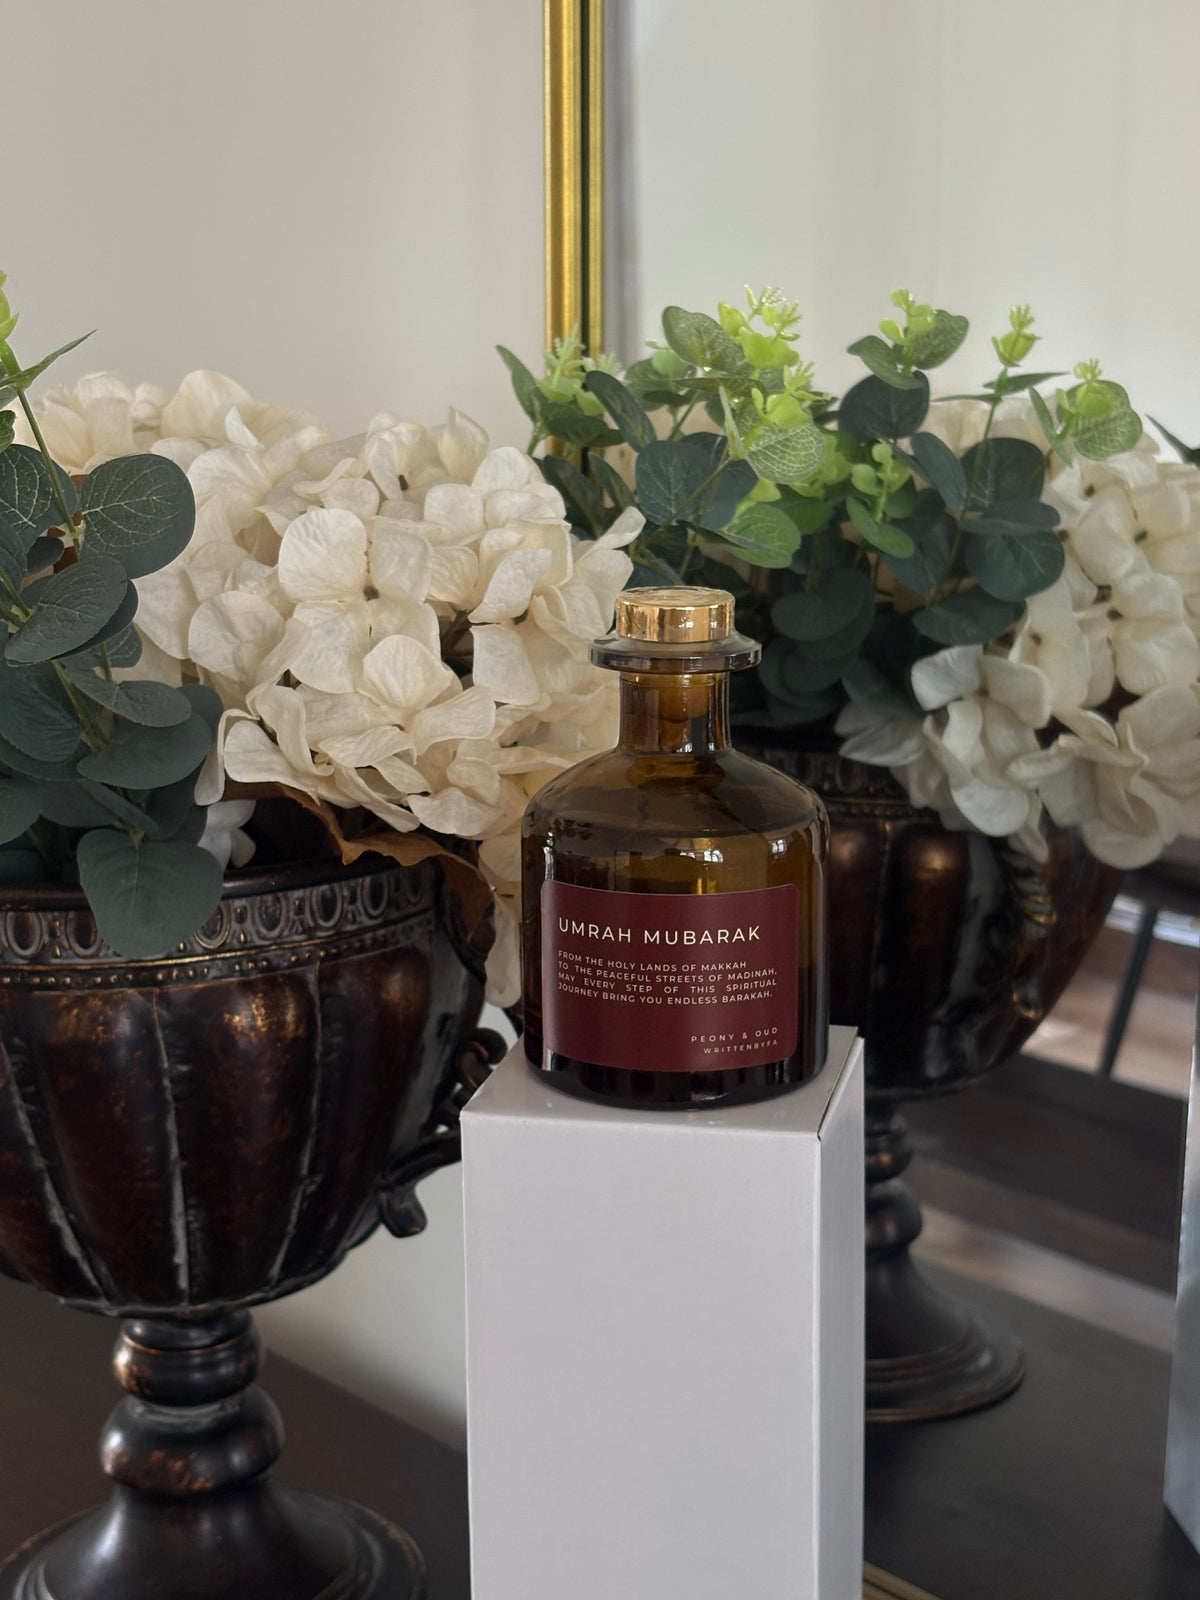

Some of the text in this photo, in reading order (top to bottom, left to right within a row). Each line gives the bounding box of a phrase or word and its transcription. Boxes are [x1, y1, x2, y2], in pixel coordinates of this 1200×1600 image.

[559, 917, 760, 945] UMRAH MUBARAK
[558, 951, 747, 972] FROM THE HOLY LANDS OF MAKKAH
[558, 962, 568, 970] TO
[575, 965, 592, 975] THE
[596, 970, 651, 982] PEACEFUL
[655, 975, 704, 983] STREETS
[709, 974, 723, 983] OF
[558, 972, 777, 994] MAY EVERY STEP OF THIS SPIRITUAL
[558, 983, 599, 998] JOURNEY
[602, 992, 635, 1003] BRING
[640, 996, 662, 1005] YOU
[667, 996, 718, 1005] ENDLESS
[691, 1027, 778, 1043] PEONY & OUD
